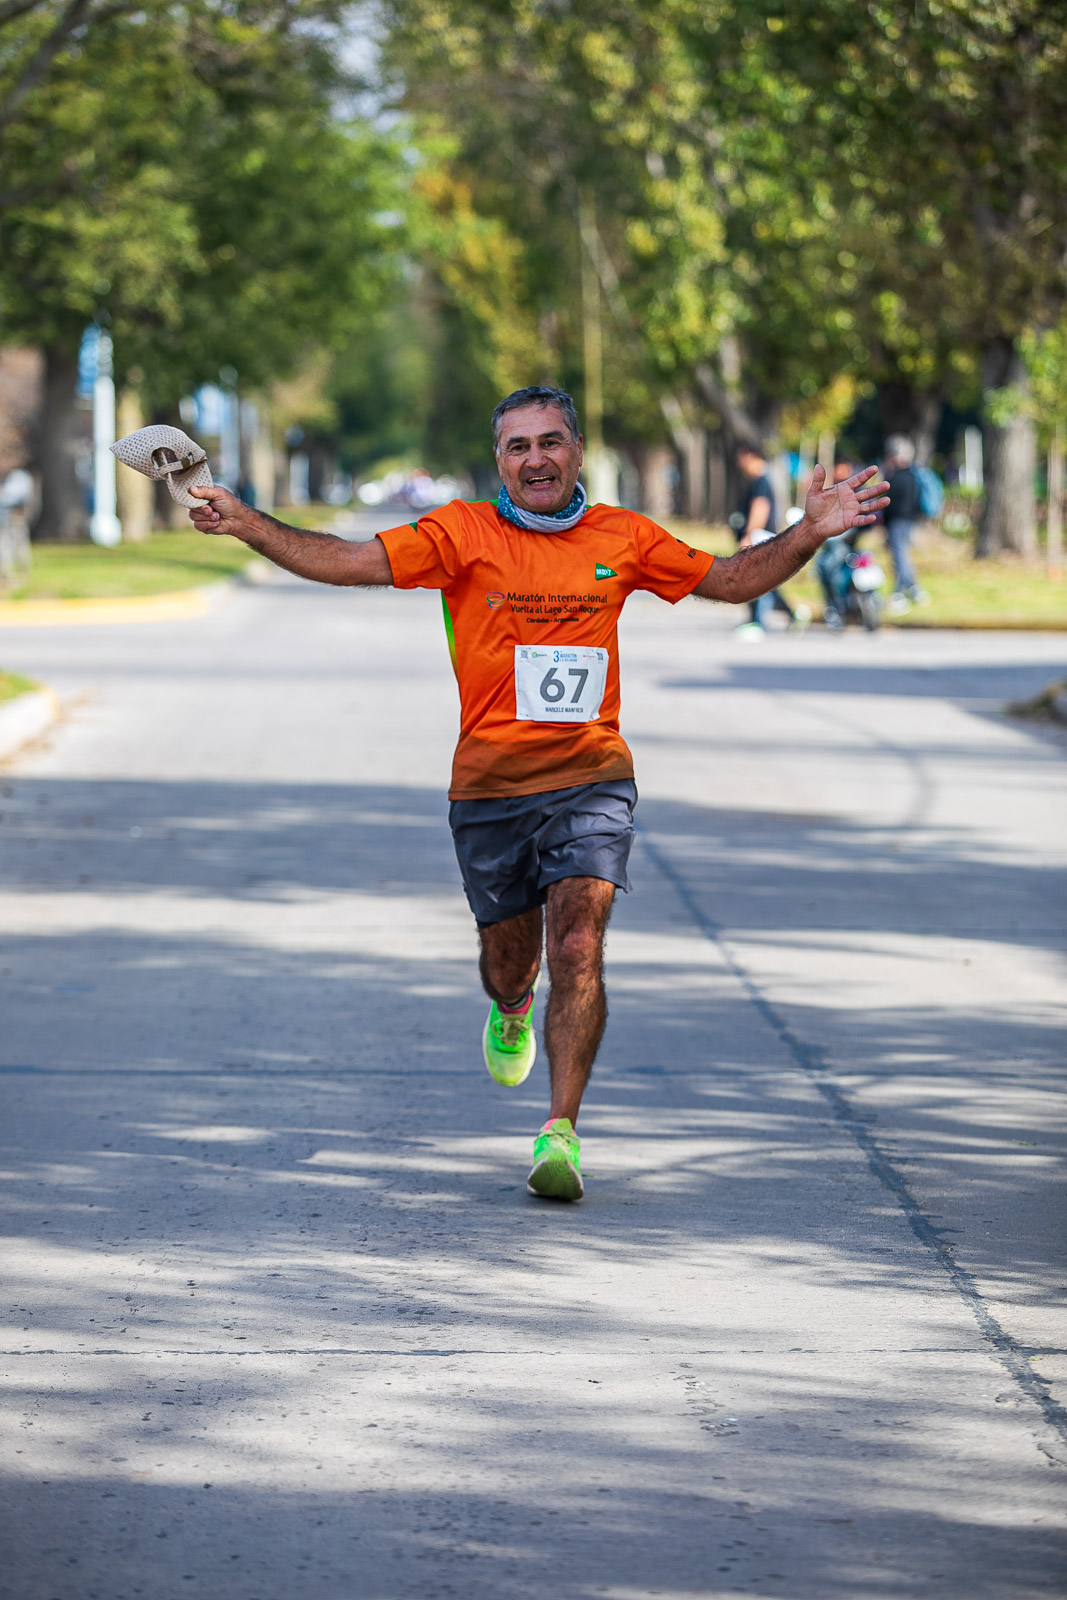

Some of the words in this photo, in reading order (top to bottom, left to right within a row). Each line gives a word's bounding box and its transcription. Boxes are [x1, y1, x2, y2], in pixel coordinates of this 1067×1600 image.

[507, 592, 546, 603] Maratón
[548, 593, 608, 604] Internacional
[510, 604, 534, 614] Vuelta
[535, 605, 543, 614] al
[544, 605, 562, 616] Lago
[564, 604, 578, 613] San
[578, 605, 600, 615] Roque
[553, 650, 560, 663] 3
[540, 667, 589, 704] 67
